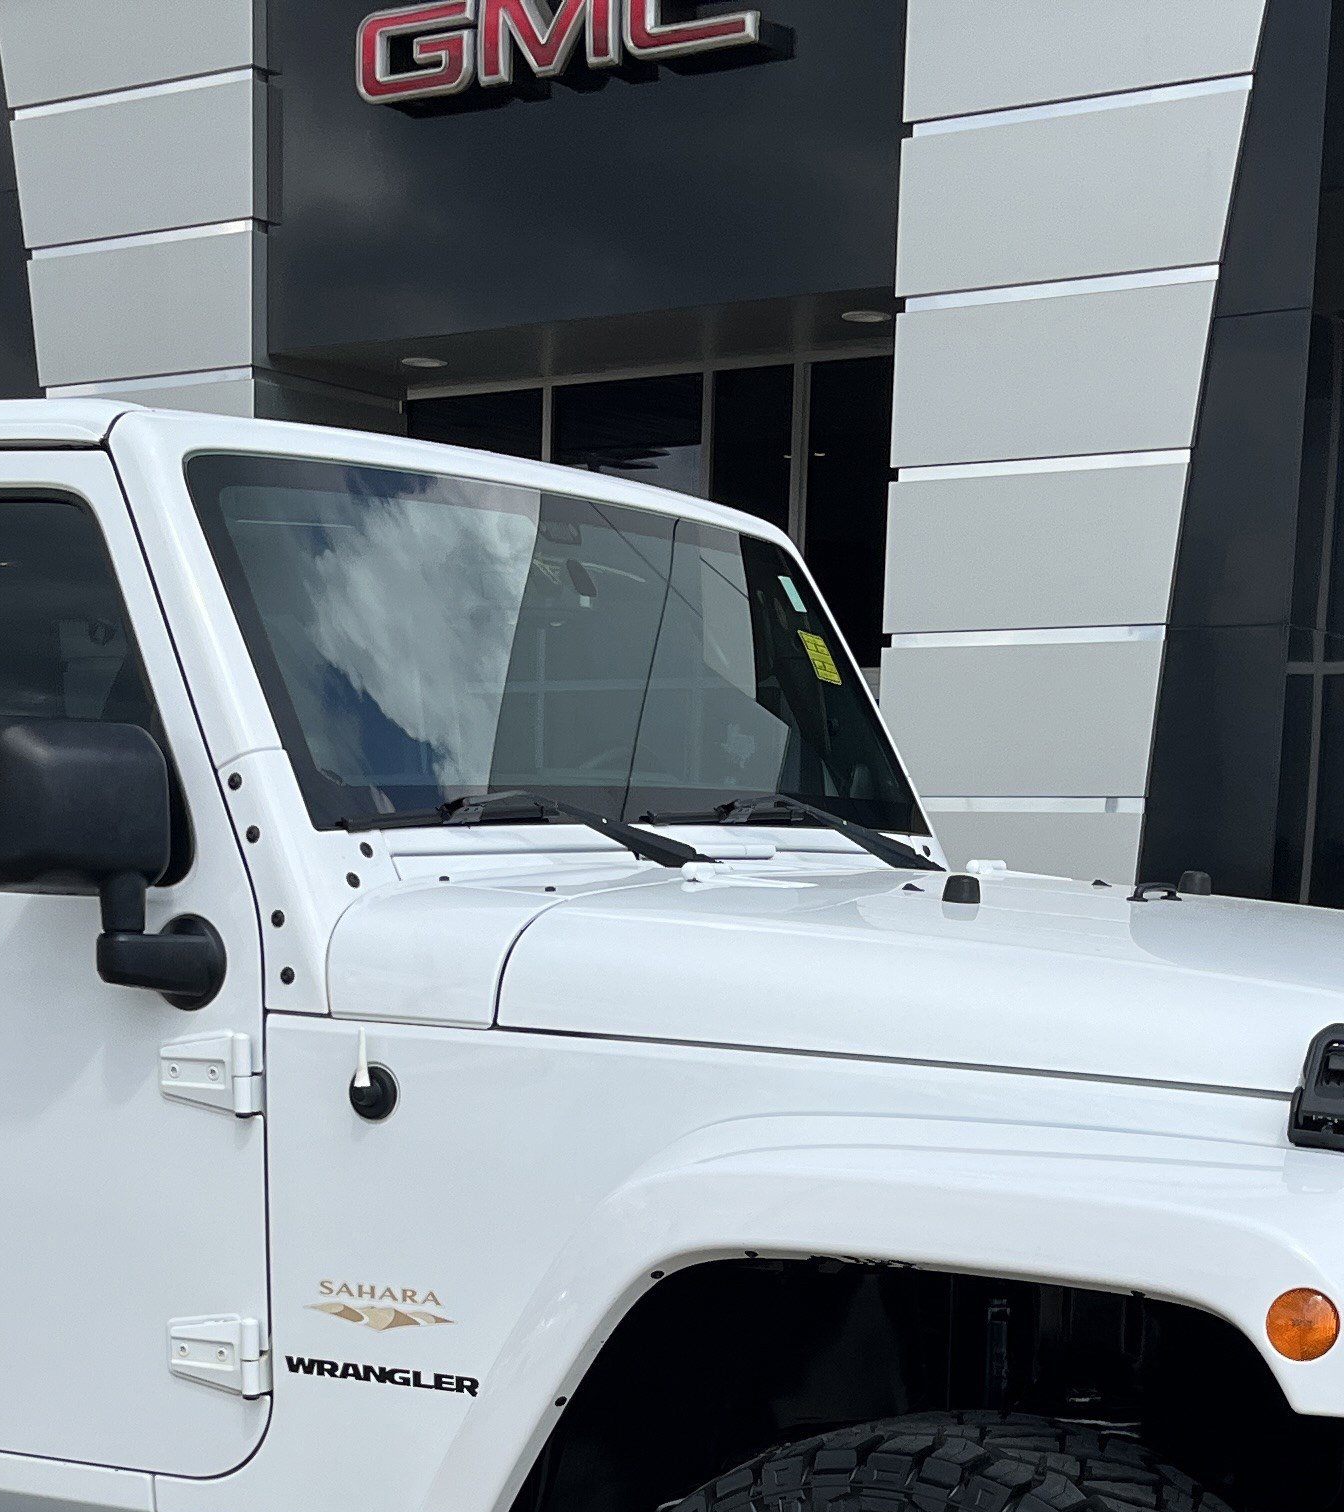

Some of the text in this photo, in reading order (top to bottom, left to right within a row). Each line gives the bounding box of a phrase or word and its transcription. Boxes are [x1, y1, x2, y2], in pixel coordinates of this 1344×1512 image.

[356, 0, 760, 104] GMC
[319, 1280, 443, 1306] SAHARA
[284, 1355, 480, 1398] WRANGLER
